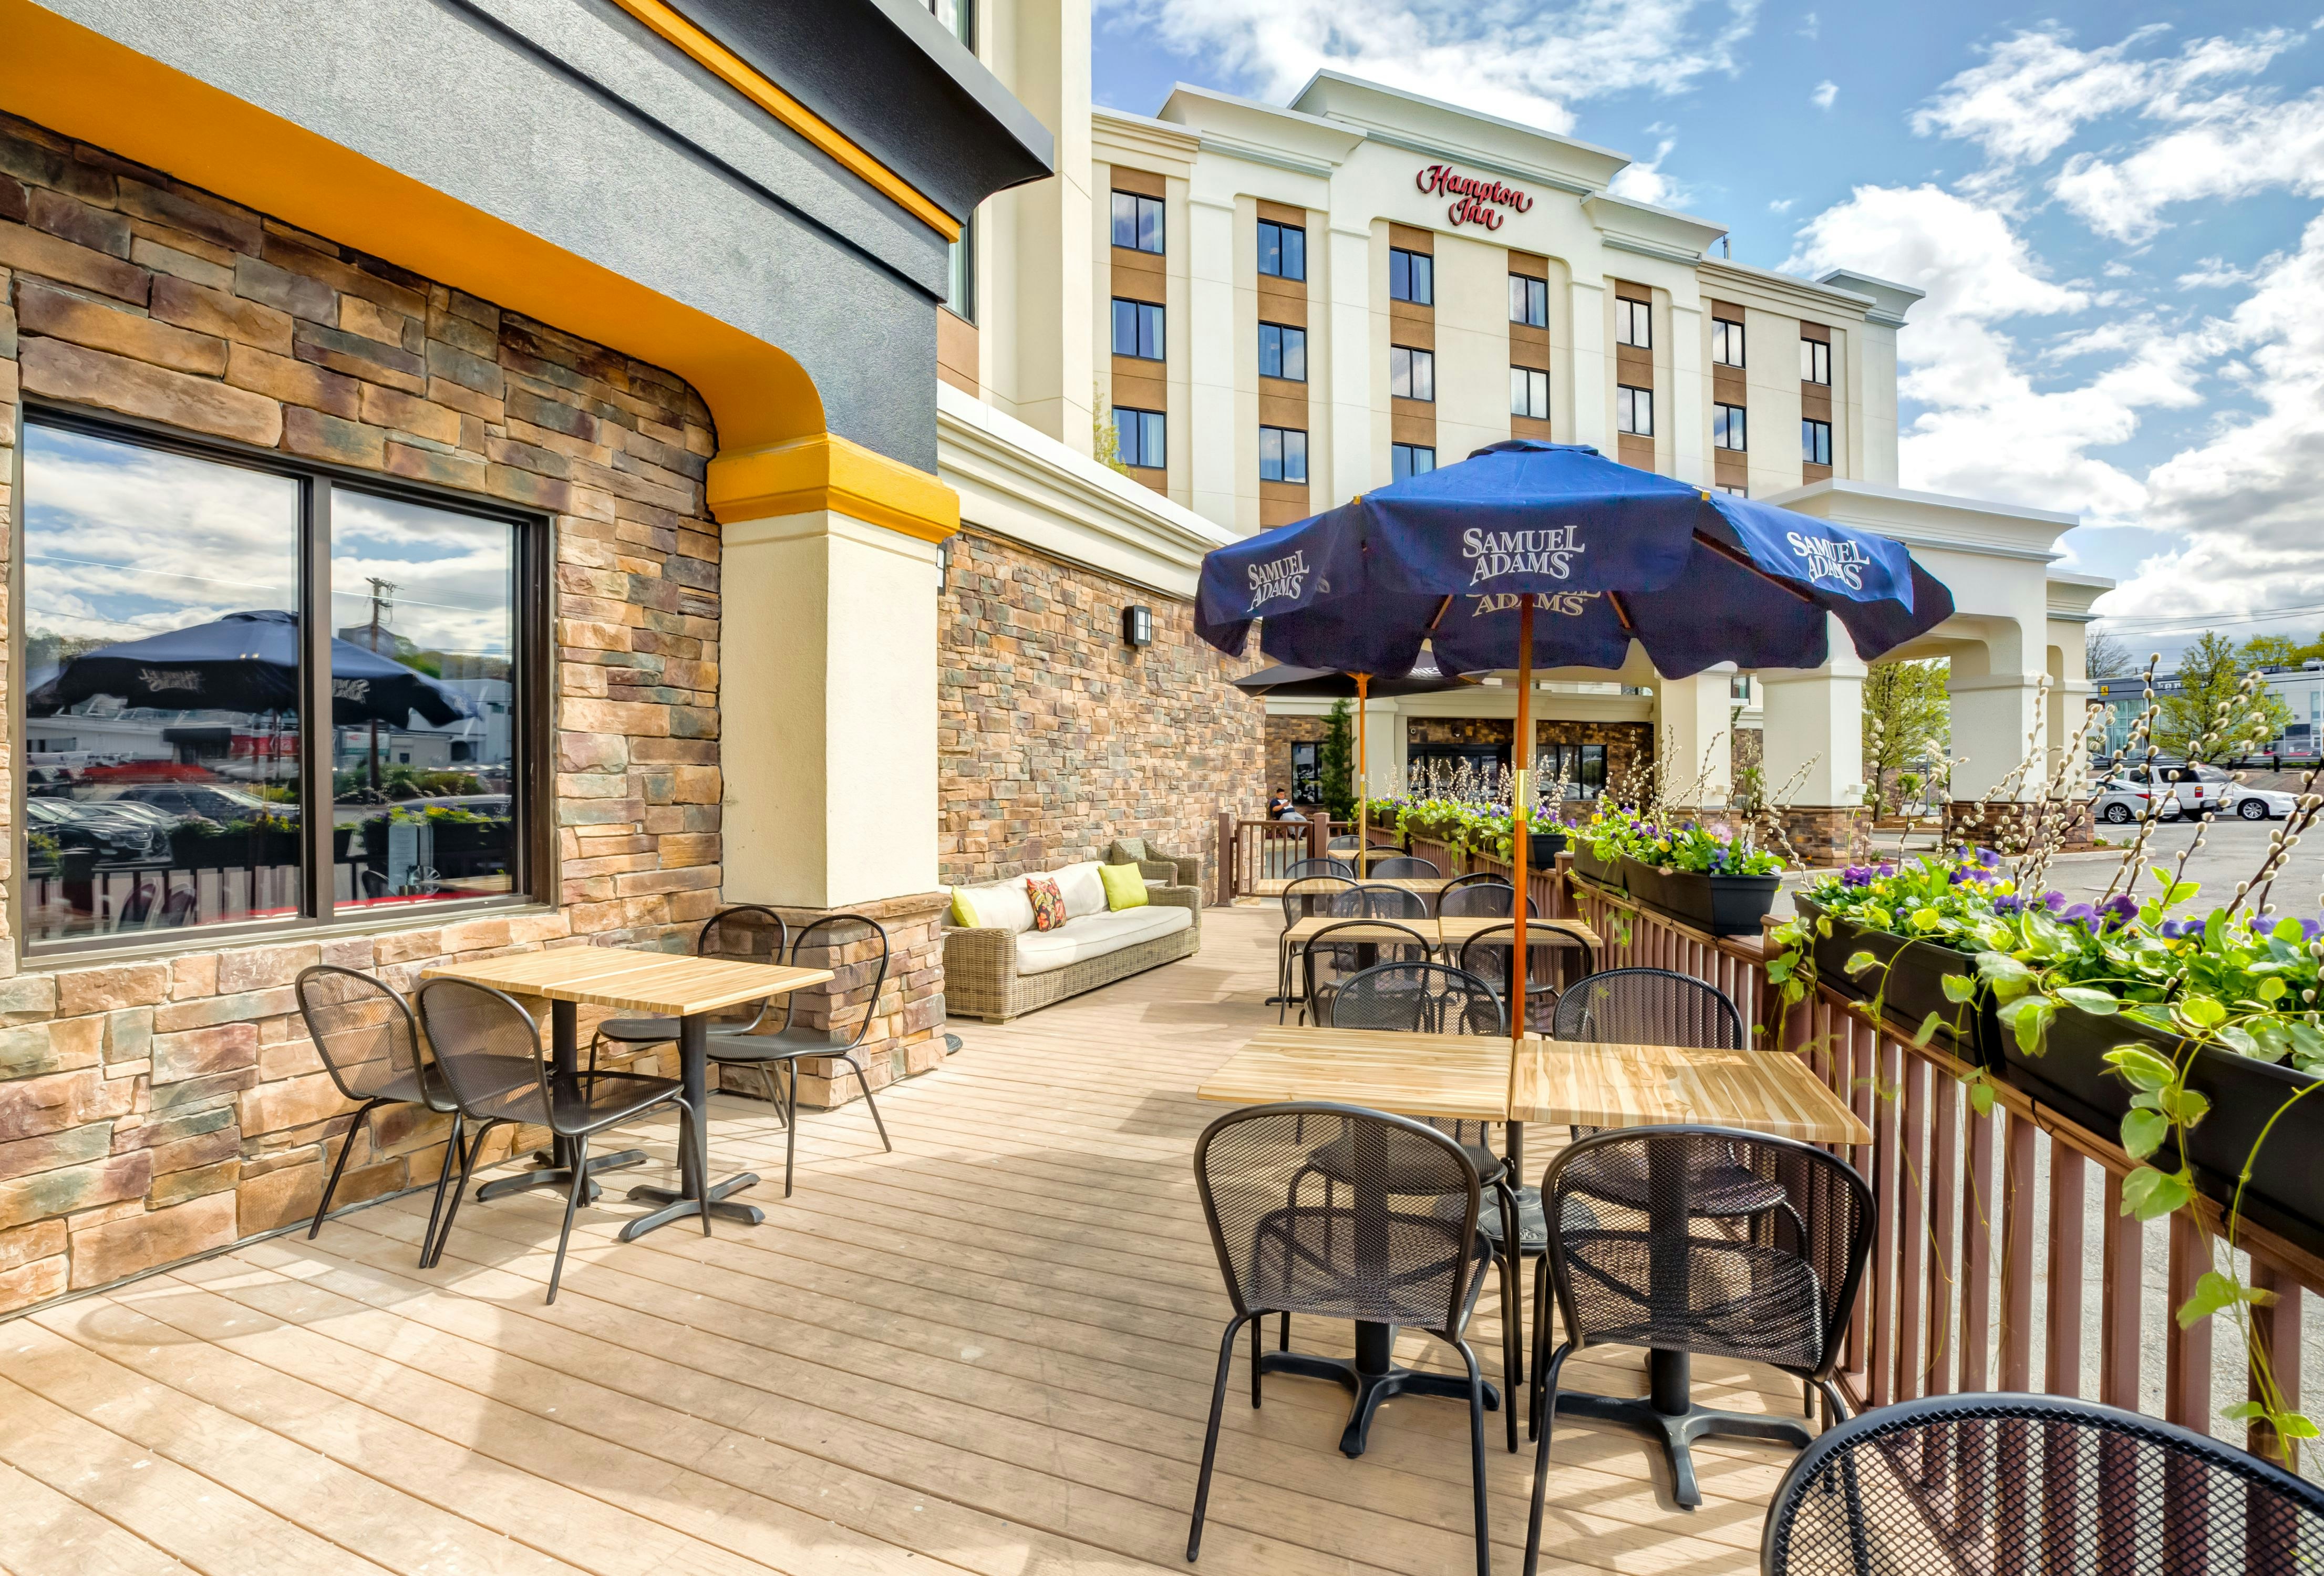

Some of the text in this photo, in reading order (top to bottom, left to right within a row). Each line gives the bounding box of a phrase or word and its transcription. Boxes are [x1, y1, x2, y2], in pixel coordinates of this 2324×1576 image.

[1416, 165, 1533, 213] Hampton
[1448, 197, 1504, 231] Inn
[1463, 525, 1585, 558] SAMUEL
[1786, 531, 1870, 565] SAMUEL
[1248, 549, 1310, 590] SAMUEL
[1470, 552, 1573, 586] ADAMS
[1808, 555, 1862, 590] ADAMS
[1246, 575, 1303, 613] ADAMS
[1472, 593, 1584, 617] ADMS
